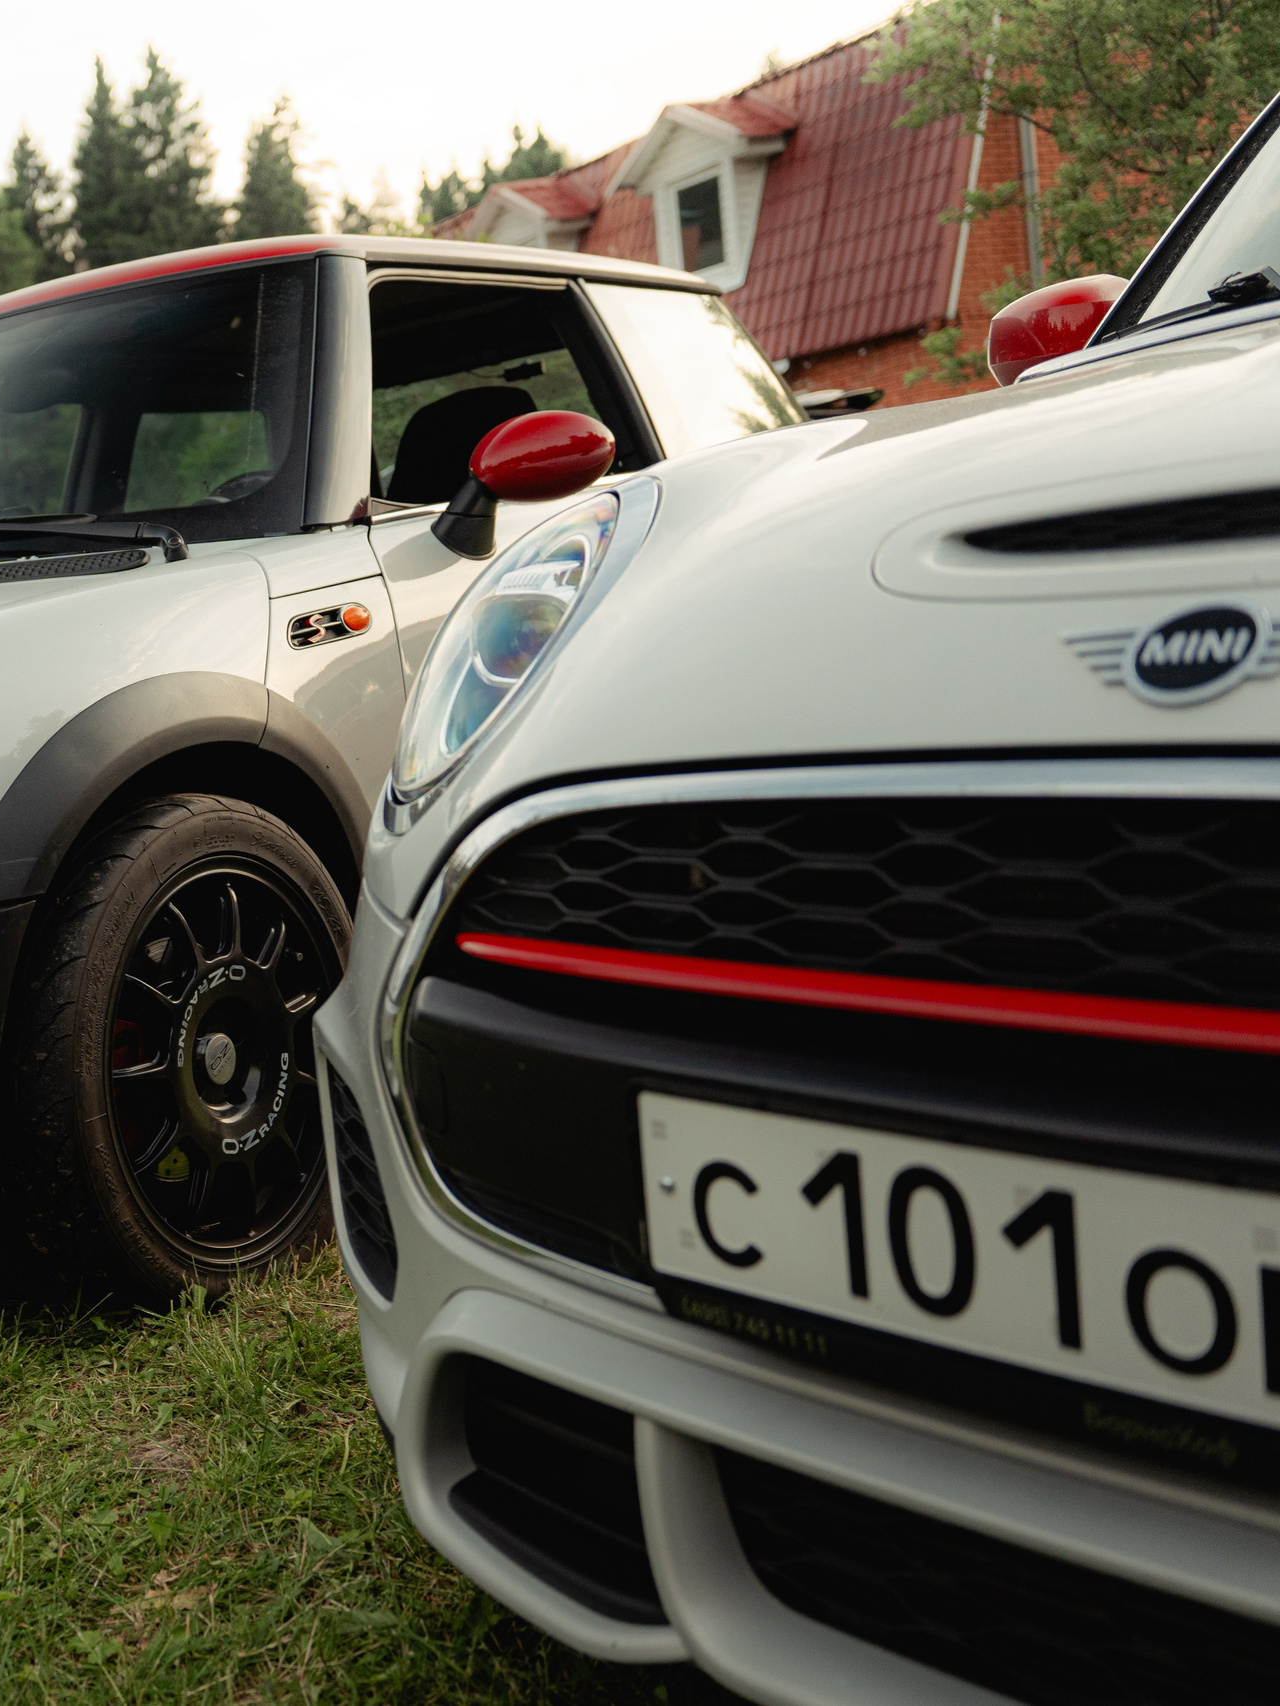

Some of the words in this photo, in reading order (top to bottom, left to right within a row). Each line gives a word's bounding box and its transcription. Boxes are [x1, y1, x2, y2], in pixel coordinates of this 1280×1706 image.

[308, 614, 326, 643] S
[1138, 627, 1250, 667] MINI
[693, 1152, 1280, 1394] C101O
